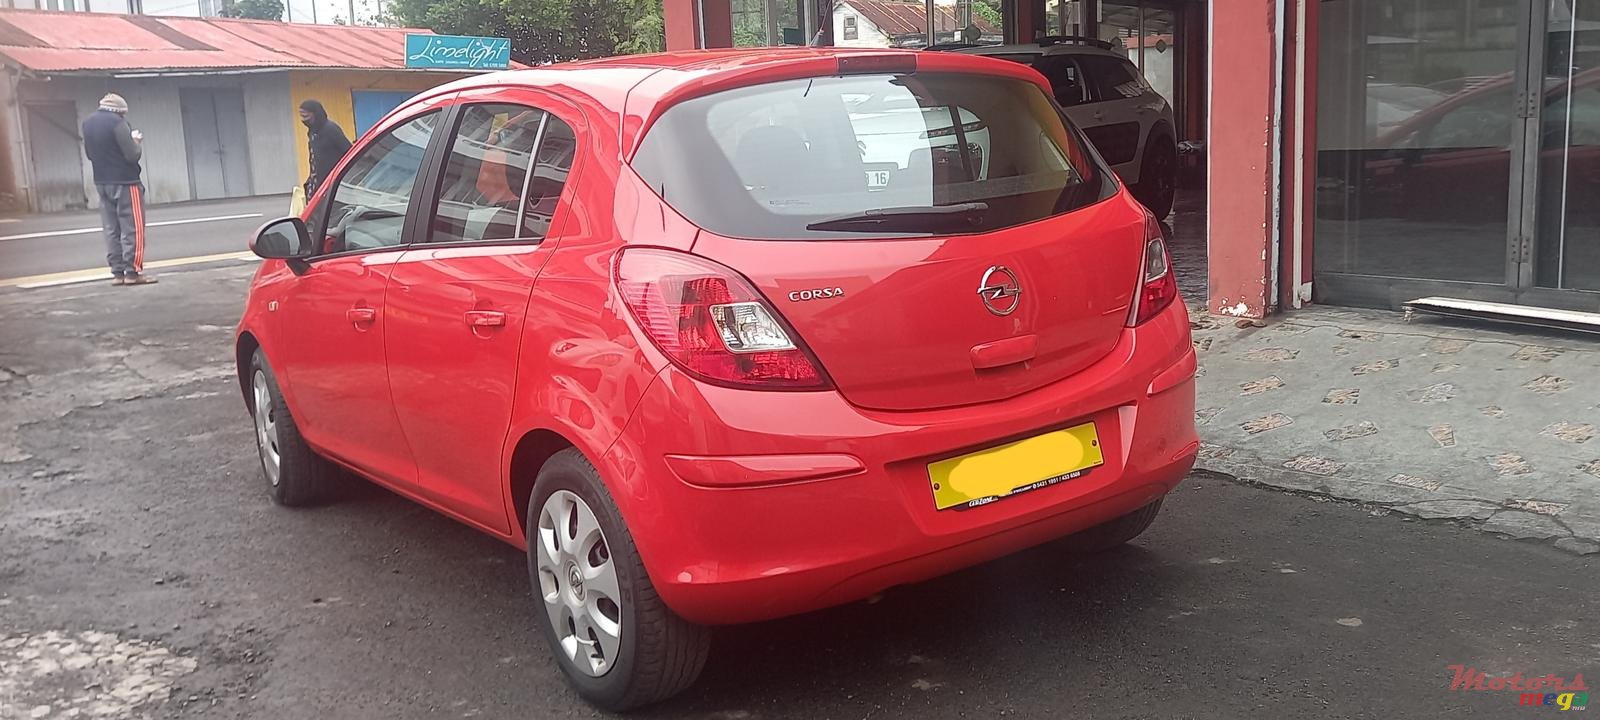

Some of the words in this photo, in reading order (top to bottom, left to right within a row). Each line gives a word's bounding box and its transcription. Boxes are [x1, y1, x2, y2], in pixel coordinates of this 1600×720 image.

[409, 37, 507, 68] Limelight
[875, 172, 887, 185] 16
[788, 287, 844, 301] CORSA
